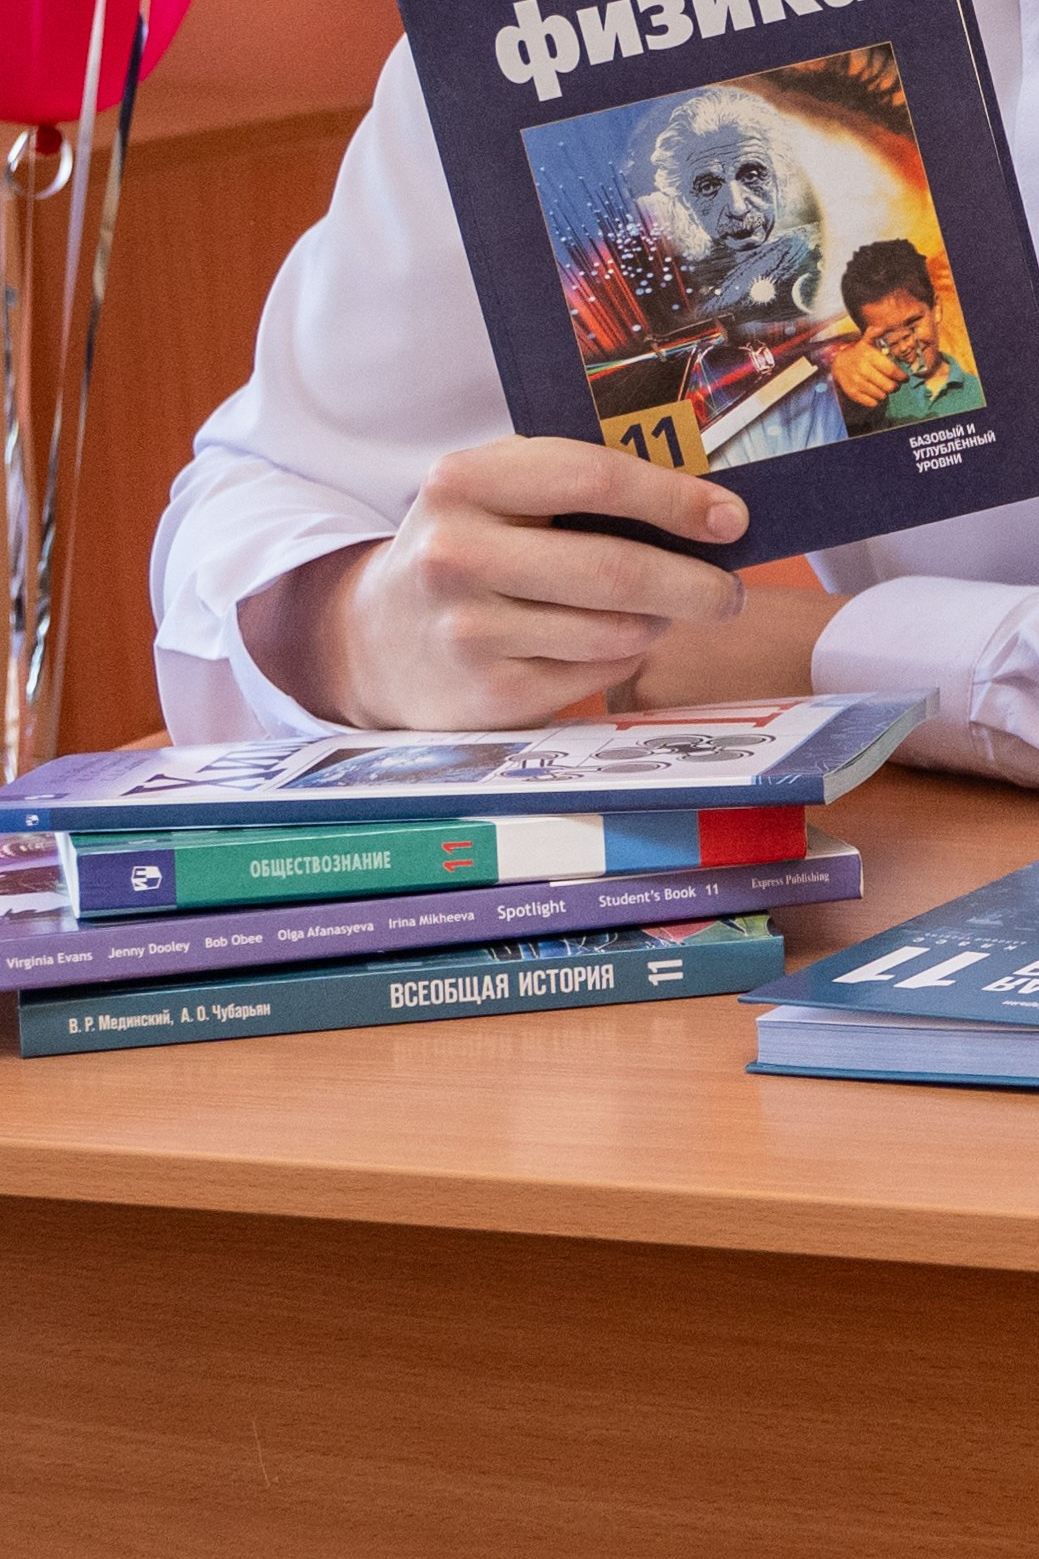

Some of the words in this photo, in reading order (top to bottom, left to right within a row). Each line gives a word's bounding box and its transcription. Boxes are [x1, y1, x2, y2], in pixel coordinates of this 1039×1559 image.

[619, 415, 686, 469] 11
[908, 423, 965, 449] БАЗОВЫЙ
[966, 422, 976, 435] И
[912, 429, 997, 461] УГЛУБЛЁННЫЙ
[915, 452, 963, 474] УРОВНИ
[249, 850, 393, 879] ОБЩЕСТВОЗНАНИЕ
[440, 841, 475, 873] 11
[6, 954, 55, 971] Virginia
[57, 952, 94, 965] Evans
[107, 946, 146, 961] Jenny
[149, 940, 191, 955] Dooley
[205, 936, 228, 949] Bob
[231, 932, 264, 946] Obee
[277, 927, 305, 942] Olga
[307, 921, 375, 938] Afanasyeva
[388, 915, 417, 930] Irina
[419, 911, 476, 926] Mikheeva
[497, 898, 568, 922] Spotlight
[598, 890, 662, 909] Student's
[664, 884, 697, 901] Book
[704, 882, 720, 896] 11
[750, 873, 785, 890] Express
[785, 870, 831, 886] Publishing
[831, 945, 992, 990] 11
[68, 1018, 82, 1035] В.
[85, 1016, 95, 1032] Р.
[98, 1009, 174, 1032] Мединский,
[181, 1006, 194, 1023] А.
[197, 1005, 209, 1022] О.
[212, 1002, 272, 1024] Чубарьян
[389, 973, 510, 1010] ВСЕОБЩАЯ
[518, 963, 616, 997] ИСТОРИЯ
[647, 958, 685, 988] 11
